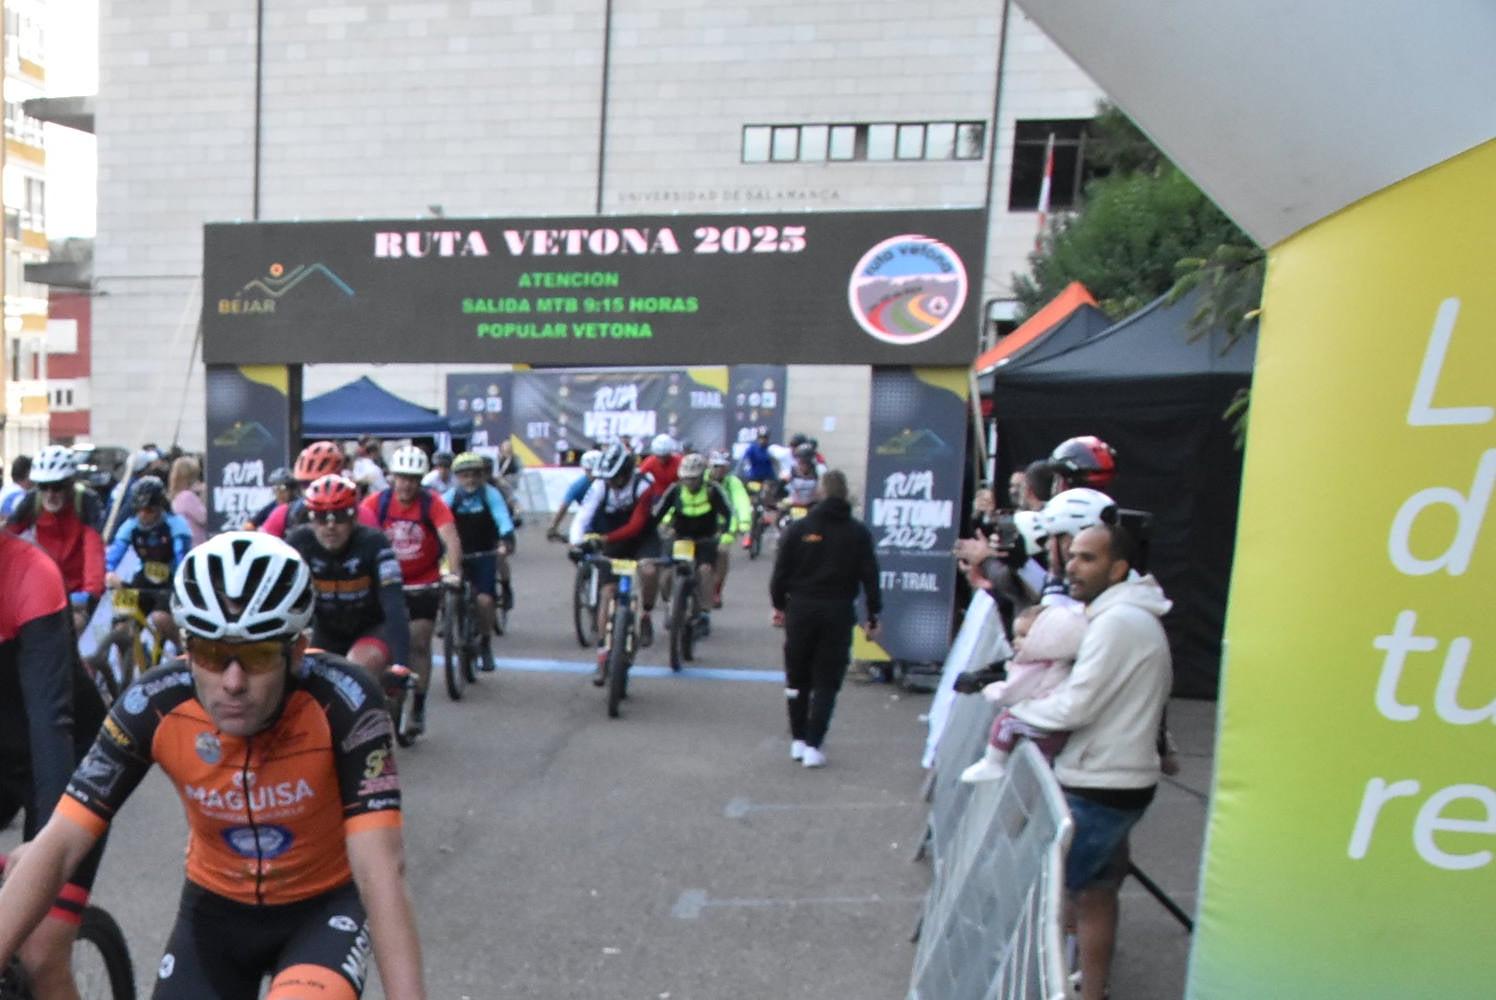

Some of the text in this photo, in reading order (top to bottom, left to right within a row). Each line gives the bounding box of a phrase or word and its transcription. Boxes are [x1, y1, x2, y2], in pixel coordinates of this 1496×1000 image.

[374, 225, 807, 258] RUTA VETONA 2025
[462, 296, 699, 314] SALIDA MTB 9:15 HORAS
[477, 321, 653, 339] POPULAR VETONA
[872, 498, 954, 528] VETONA
[878, 525, 937, 550] 2025
